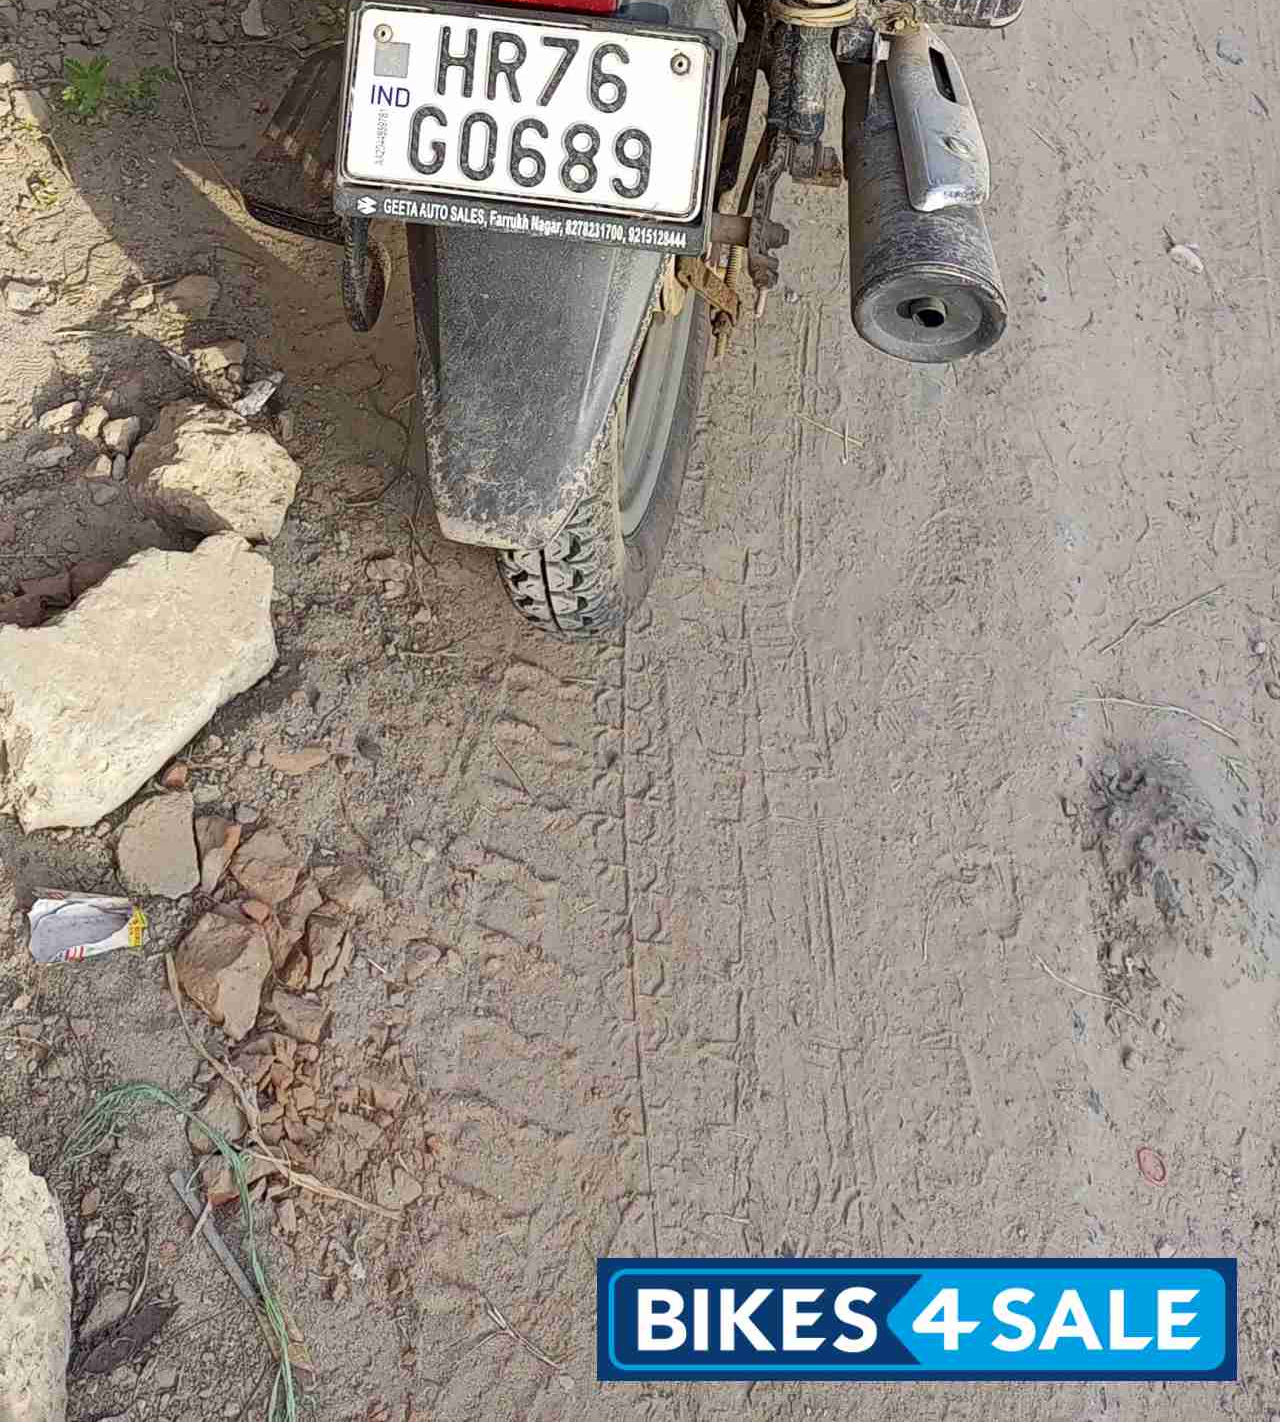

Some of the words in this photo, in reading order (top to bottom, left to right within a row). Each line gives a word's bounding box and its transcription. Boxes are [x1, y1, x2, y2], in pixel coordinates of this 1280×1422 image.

[371, 84, 410, 108] IND
[433, 25, 631, 114] HR76
[407, 104, 653, 199] G0689
[383, 198, 418, 218] GEETA
[419, 201, 449, 221] AUTO
[449, 205, 489, 228] SALES,
[489, 210, 529, 231] Farrukh
[530, 215, 563, 236] Nagar,
